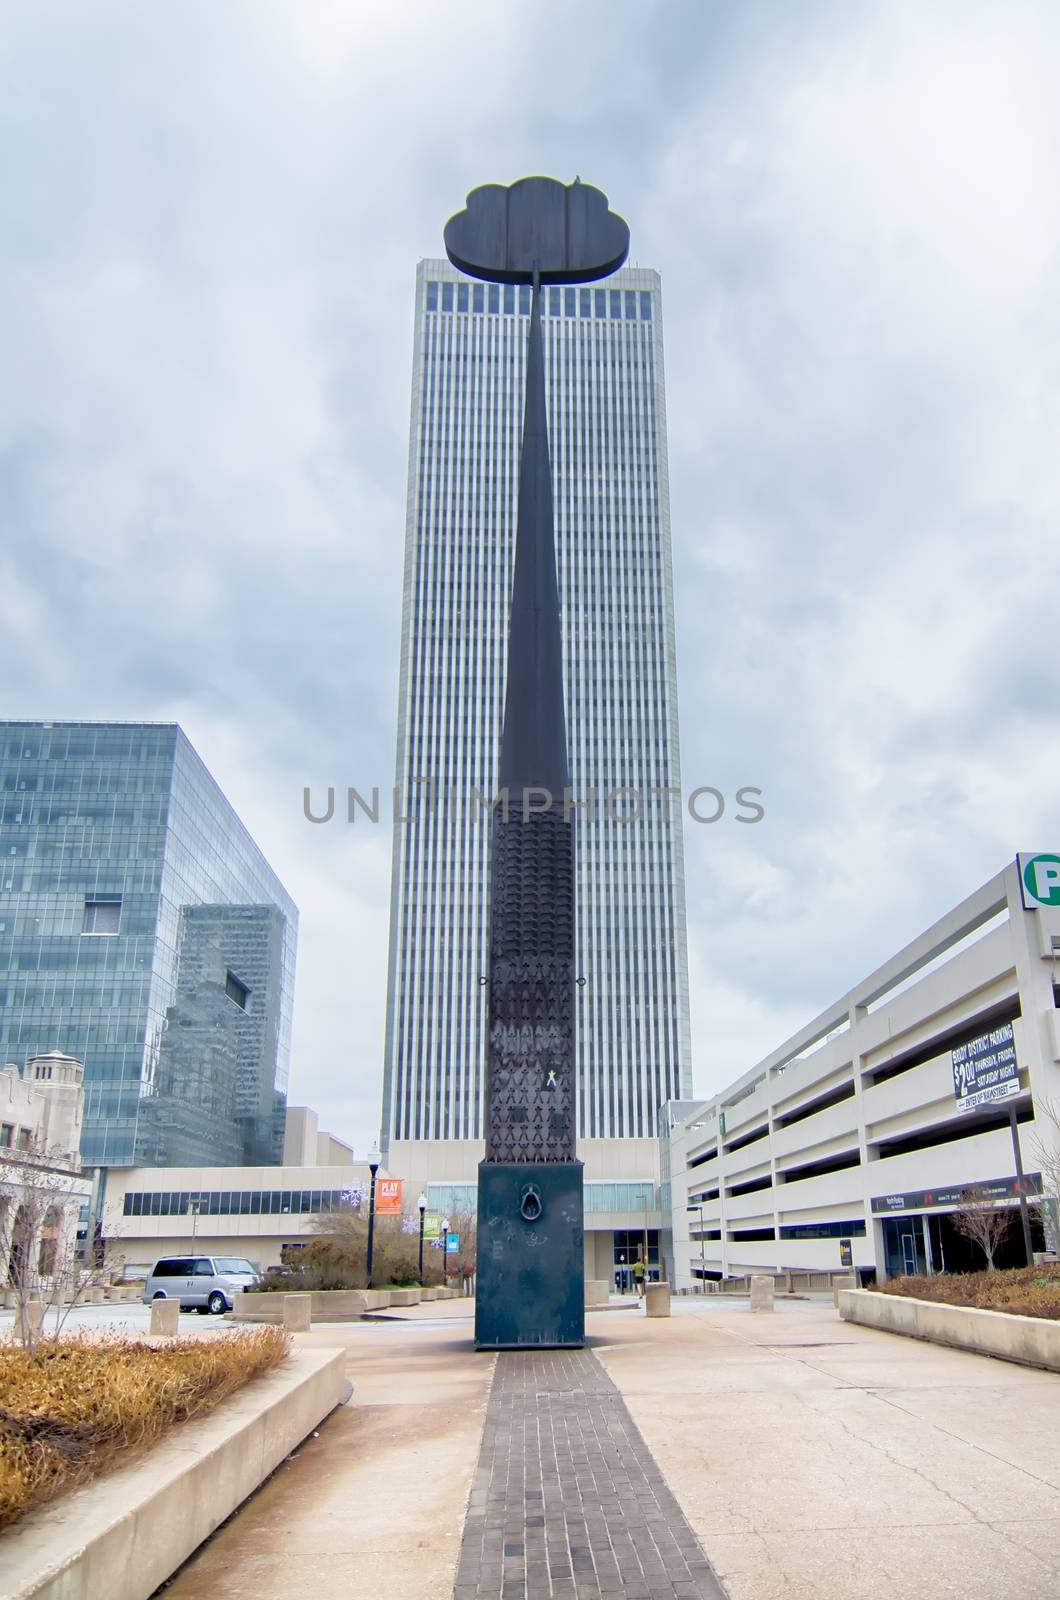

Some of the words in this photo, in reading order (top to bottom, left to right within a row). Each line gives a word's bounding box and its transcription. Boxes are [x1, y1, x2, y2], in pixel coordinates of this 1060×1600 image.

[1033, 861, 1060, 898] P
[968, 1035, 989, 1056] DISTRICT
[990, 1024, 1012, 1046] PARKING
[977, 1071, 999, 1087] SATURDAY
[382, 1183, 398, 1192] PLAY
